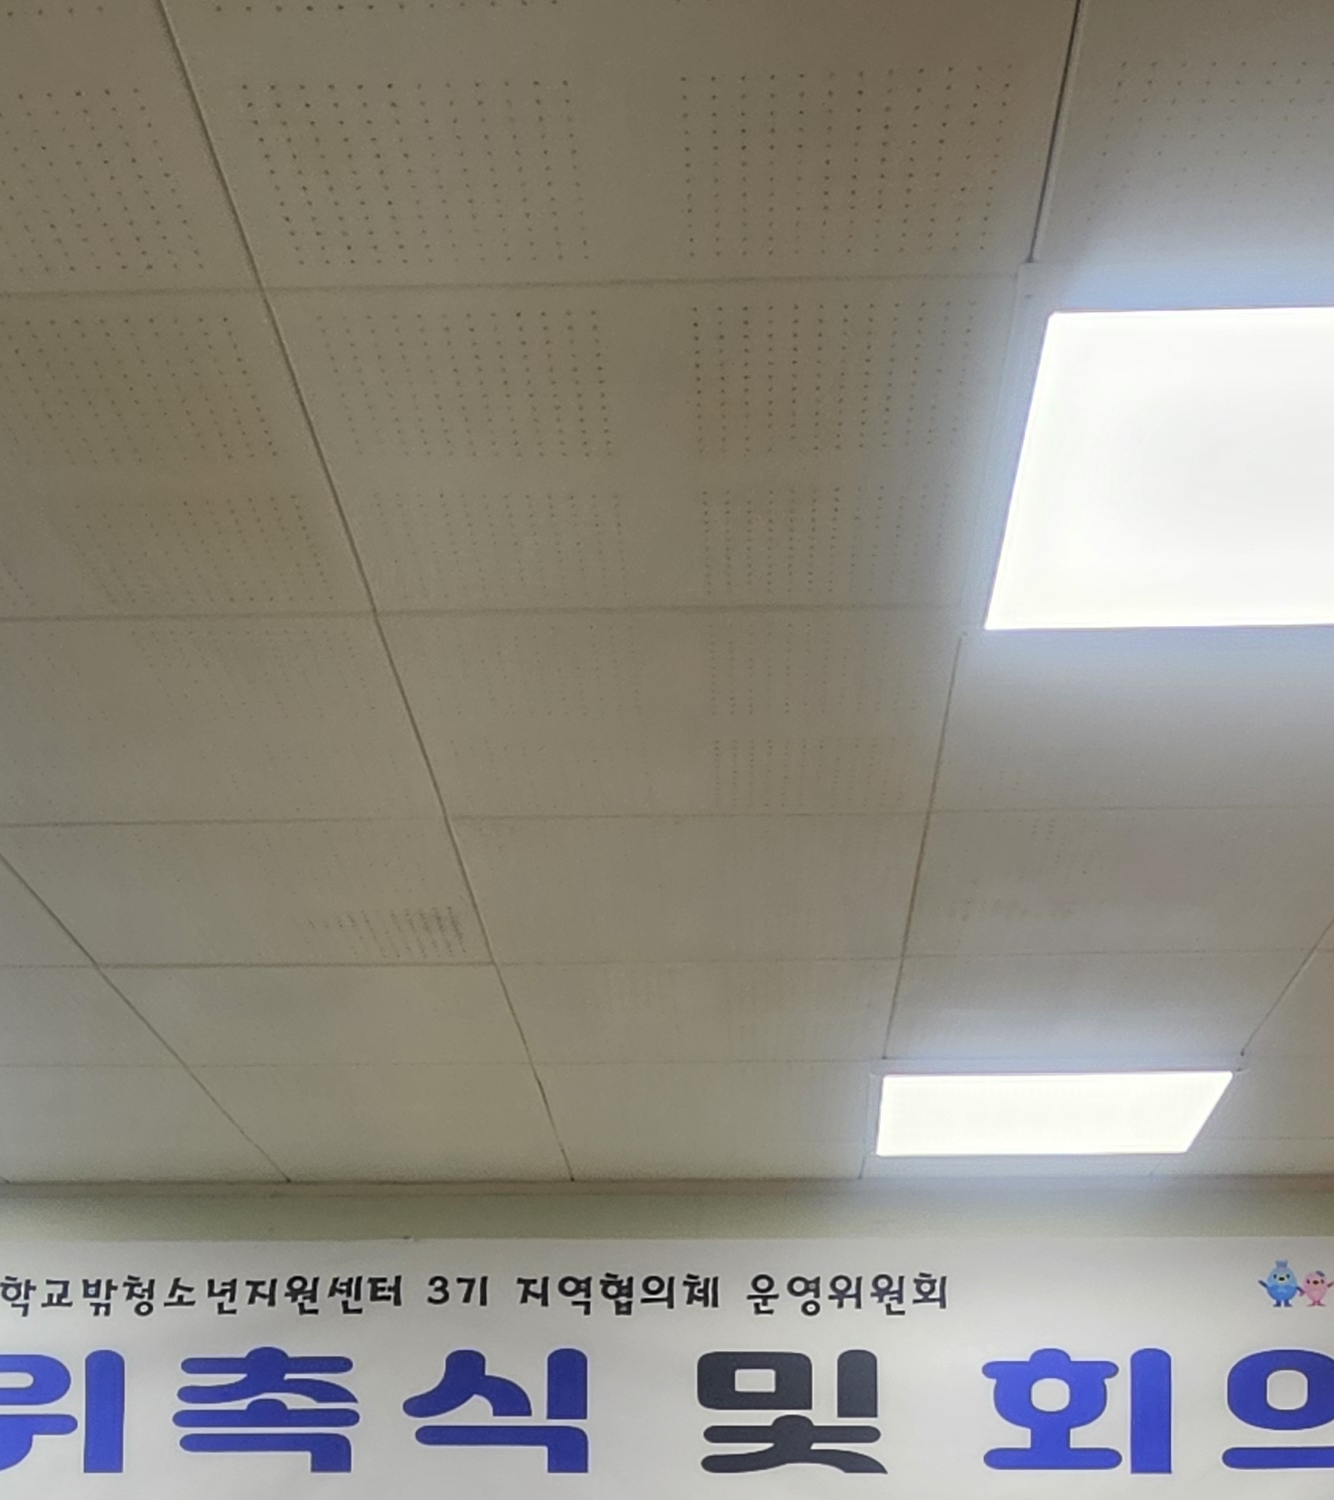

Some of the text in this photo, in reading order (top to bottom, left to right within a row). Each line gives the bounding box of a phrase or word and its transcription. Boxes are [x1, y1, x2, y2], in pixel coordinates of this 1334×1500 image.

[427, 1275, 489, 1308] 3기
[516, 1272, 719, 1316] 지역협의체
[746, 1272, 948, 1317] 운영위원회
[696, 1349, 888, 1475] 및
